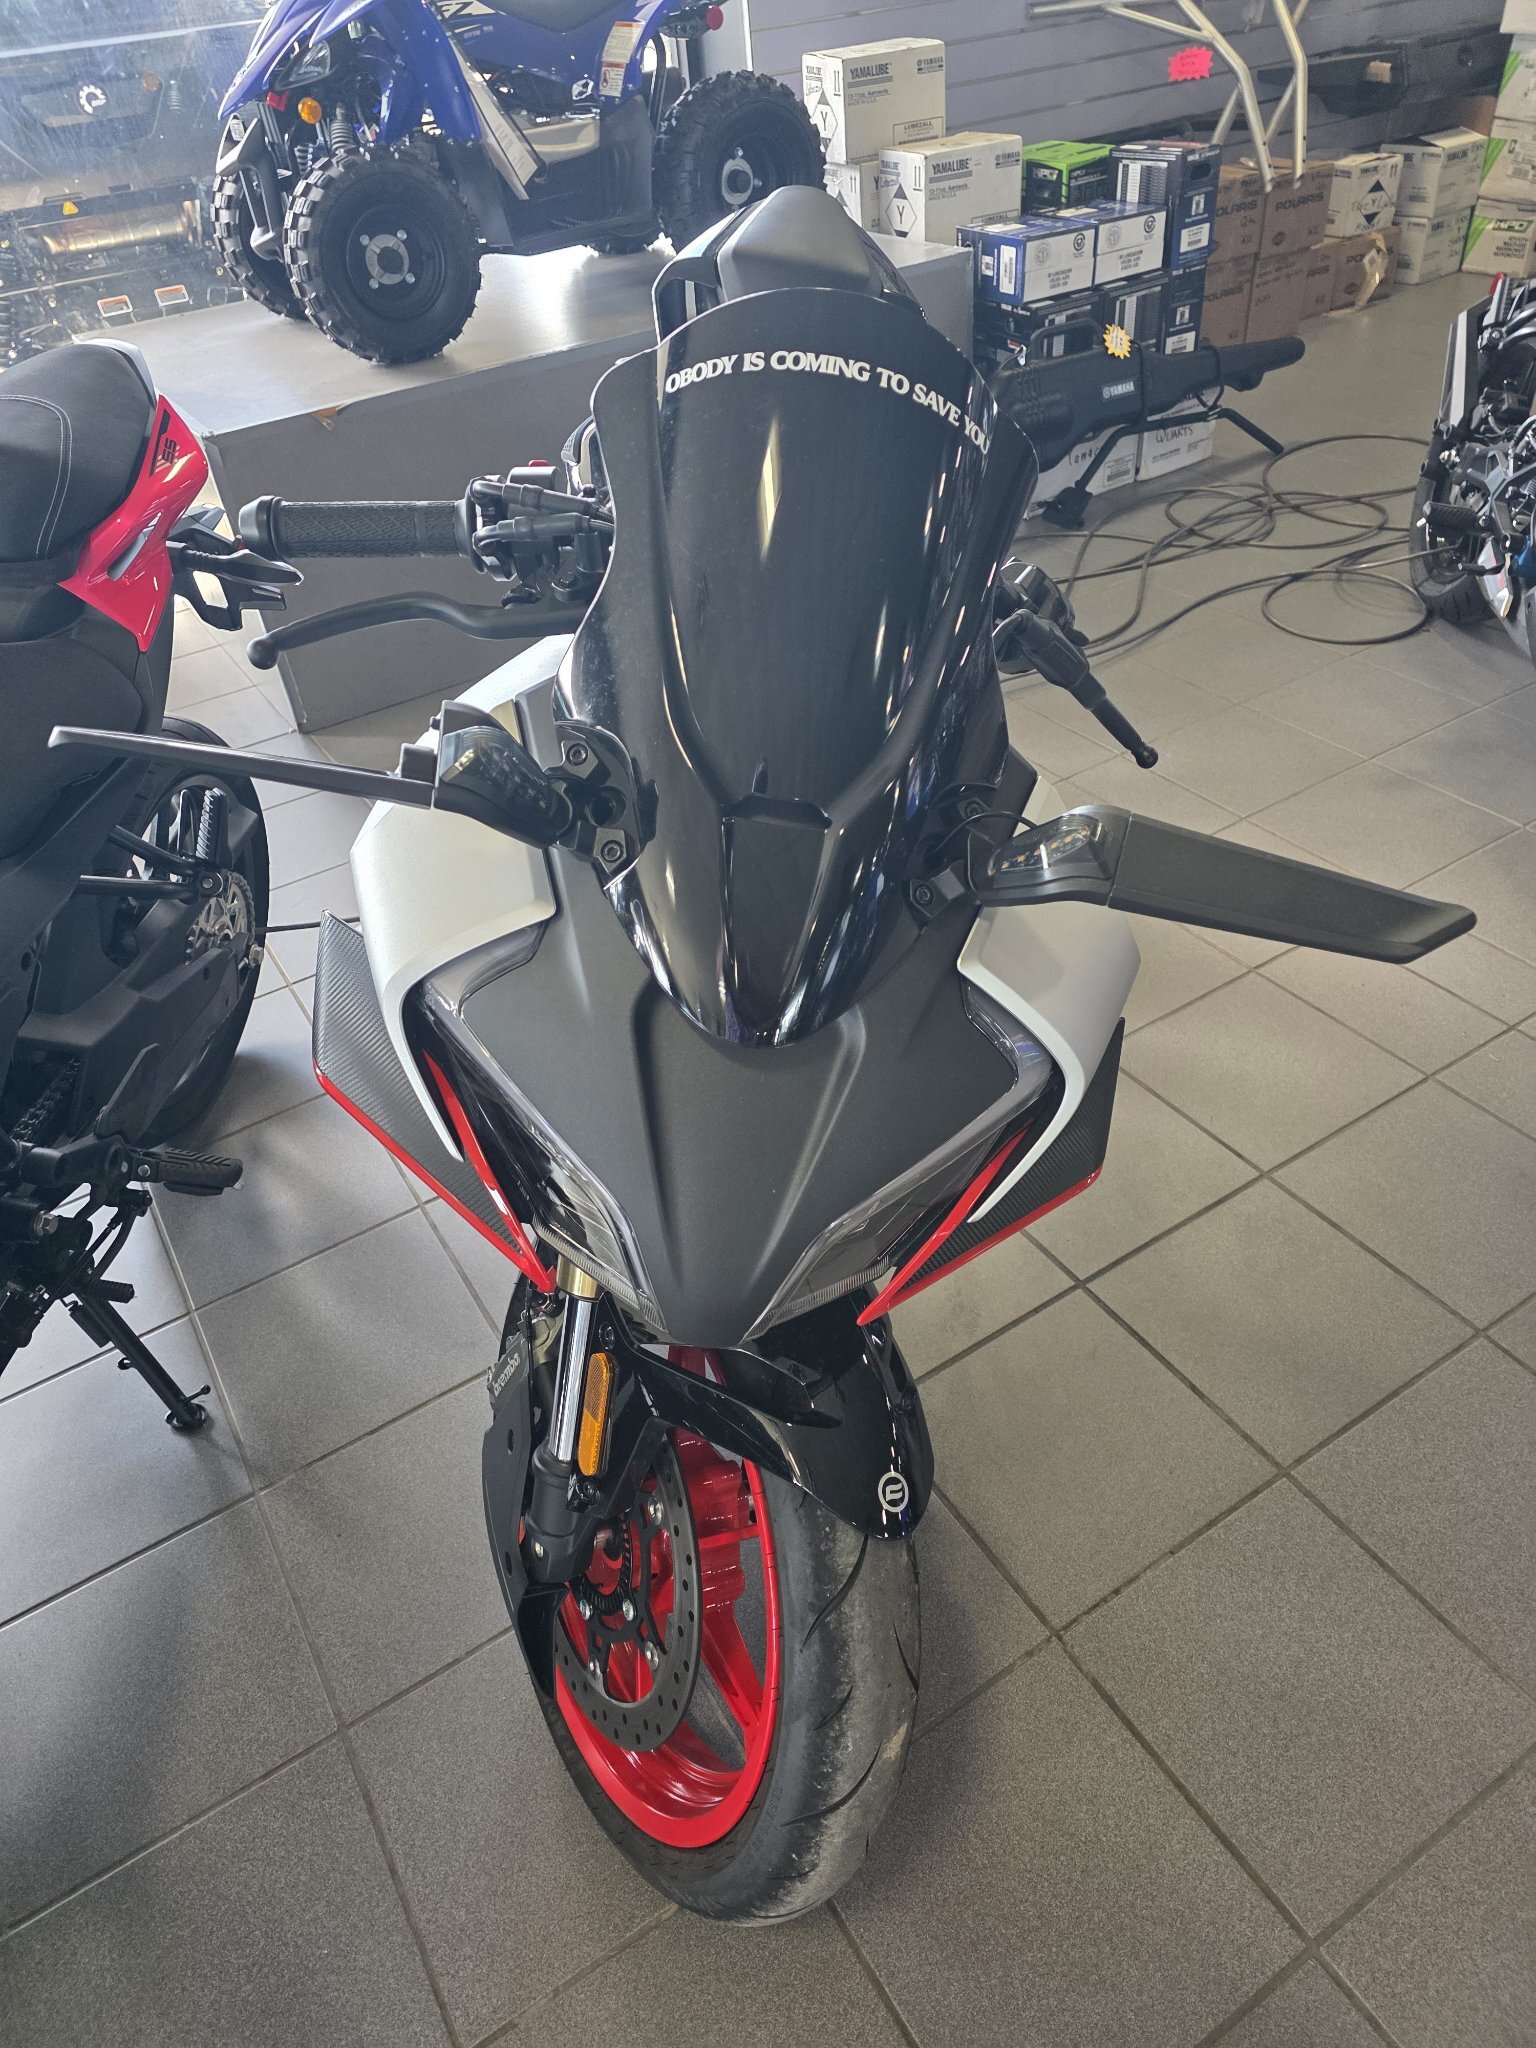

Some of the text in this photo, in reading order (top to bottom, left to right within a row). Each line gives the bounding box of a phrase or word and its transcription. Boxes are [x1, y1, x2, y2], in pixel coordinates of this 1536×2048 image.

[849, 63, 890, 80] YAMALUBE
[932, 158, 972, 175] YAMALUBE
[1216, 201, 1258, 217] OLARIS
[1275, 192, 1324, 212] POLARIS
[896, 204, 905, 225] Y
[1207, 285, 1245, 302] OLARIS
[1111, 381, 1135, 396] YAMAHA
[665, 350, 991, 455] OBODY IS COMING TO SAVE YOU
[492, 1353, 520, 1398] brembo
